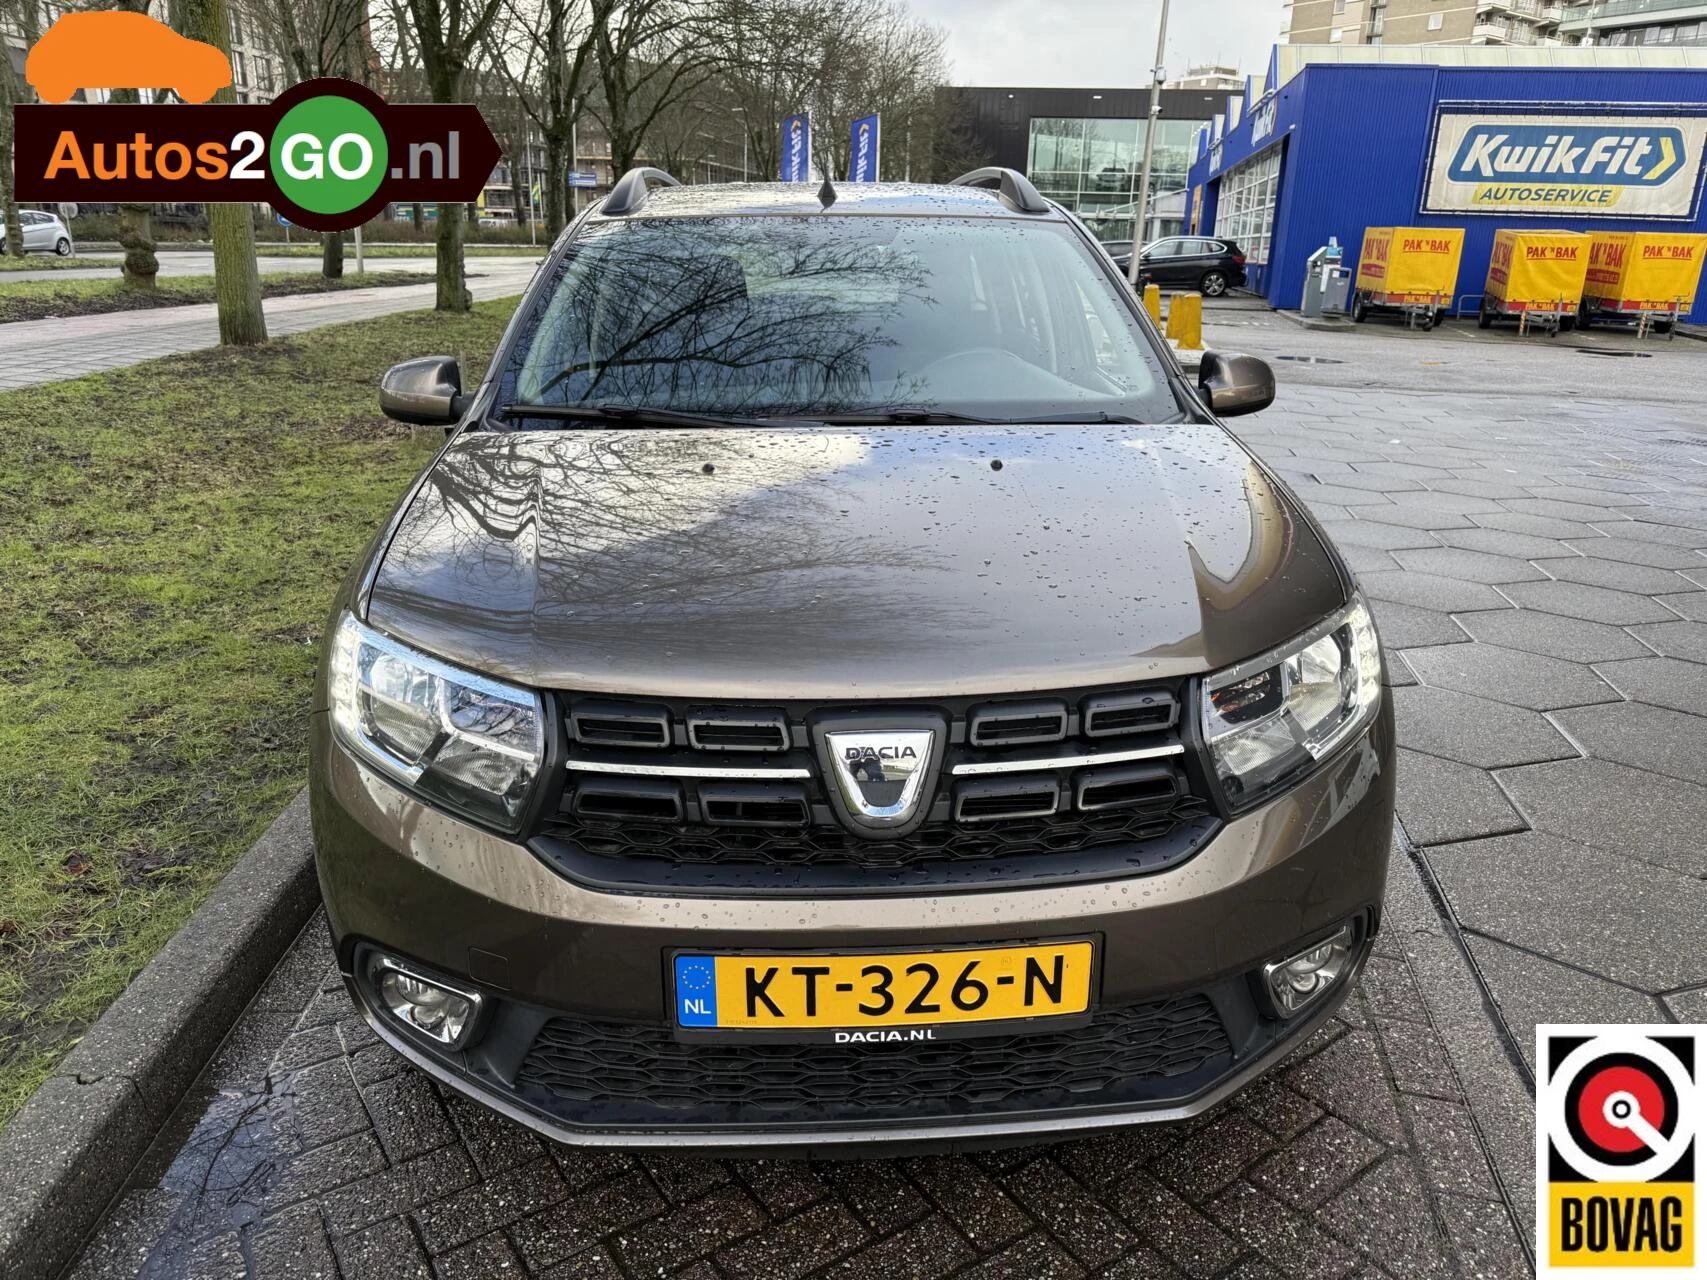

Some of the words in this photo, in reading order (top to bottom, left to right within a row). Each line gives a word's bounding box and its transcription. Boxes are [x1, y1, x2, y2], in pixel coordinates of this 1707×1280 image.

[1480, 187, 1612, 203] AUTOSERVICE
[1403, 239, 1423, 250] PAK
[1430, 239, 1451, 252] BAK
[1526, 246, 1548, 257] PAK
[1555, 246, 1579, 258] BAK
[1643, 245, 1665, 257] PAK
[1672, 246, 1695, 258] BAK
[845, 746, 917, 760] DACIA
[684, 999, 712, 1014] NL
[746, 954, 1064, 1018] KT-326-N
[835, 1029, 936, 1043] DACIA.NL
